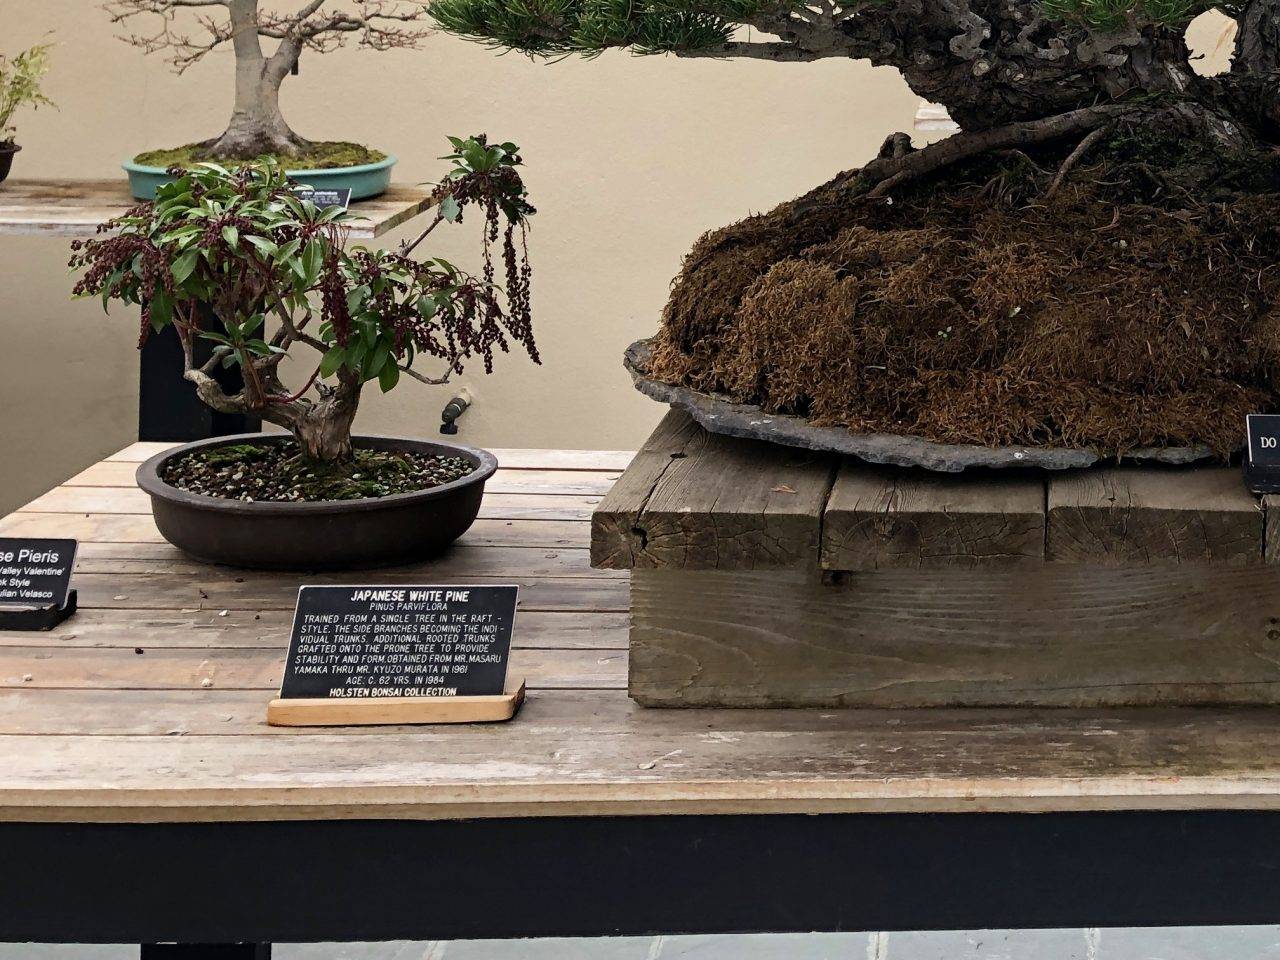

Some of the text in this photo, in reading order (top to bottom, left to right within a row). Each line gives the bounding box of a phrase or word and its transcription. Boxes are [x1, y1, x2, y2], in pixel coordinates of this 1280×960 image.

[1261, 437, 1276, 448] DO
[18, 549, 59, 563] Pieris
[9, 579, 30, 588] Style
[20, 590, 52, 598] Velasco
[351, 590, 469, 602] JAPANESE WHITE PINE
[370, 603, 448, 611] PINUS PARVIFLORA
[304, 615, 339, 624] TRAINED
[344, 615, 367, 623] FROM
[371, 615, 377, 623] A
[380, 615, 409, 623] SINGLE
[415, 615, 435, 623] TREE
[439, 615, 448, 623] IN
[451, 615, 468, 623] THE
[471, 615, 492, 623] RAFT
[335, 625, 350, 633] THE
[353, 625, 371, 633] SIDE
[374, 625, 418, 633] BRANCHES
[420, 625, 462, 633] BECOMING
[464, 625, 479, 633] THE
[481, 625, 498, 633] INDI
[300, 635, 329, 644] VIDUAL
[374, 635, 421, 644] ADDITIONAL
[426, 635, 459, 644] ROOTED
[464, 635, 496, 644] TRUNKS
[298, 645, 489, 653] GRAFTED ONTO THE PRONE TREE TO PROVIDE
[295, 655, 339, 663] STABILITY
[342, 655, 359, 663] AND
[429, 655, 452, 663] FROM
[294, 665, 328, 674] YAMAKA
[331, 665, 353, 674] THRU
[374, 665, 402, 674] KYUZO
[404, 665, 438, 674] MURATA
[441, 665, 450, 674] IN
[451, 665, 468, 674] 1961
[379, 676, 390, 684] 62
[415, 676, 423, 684] IN
[425, 676, 444, 684] 1984
[330, 688, 457, 697] HOLSTEN BONSAI COLLECTION
